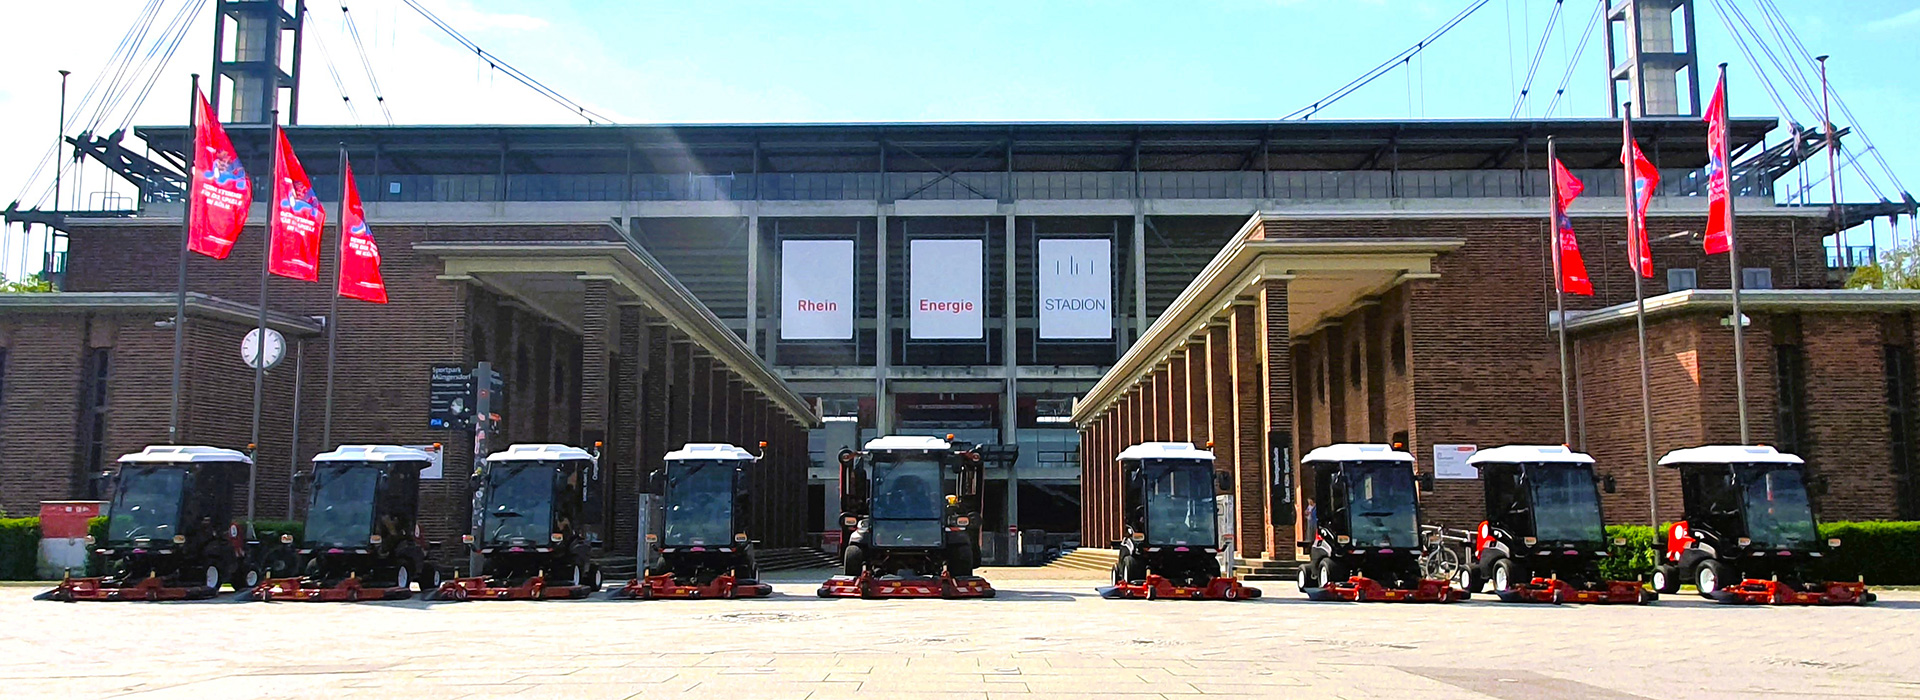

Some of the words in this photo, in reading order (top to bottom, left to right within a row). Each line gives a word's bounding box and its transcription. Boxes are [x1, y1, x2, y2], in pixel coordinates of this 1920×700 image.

[798, 299, 836, 312] Rhein
[919, 298, 972, 314] Energie
[1044, 298, 1105, 311] STADION
[432, 373, 471, 382] Müngersdorf
